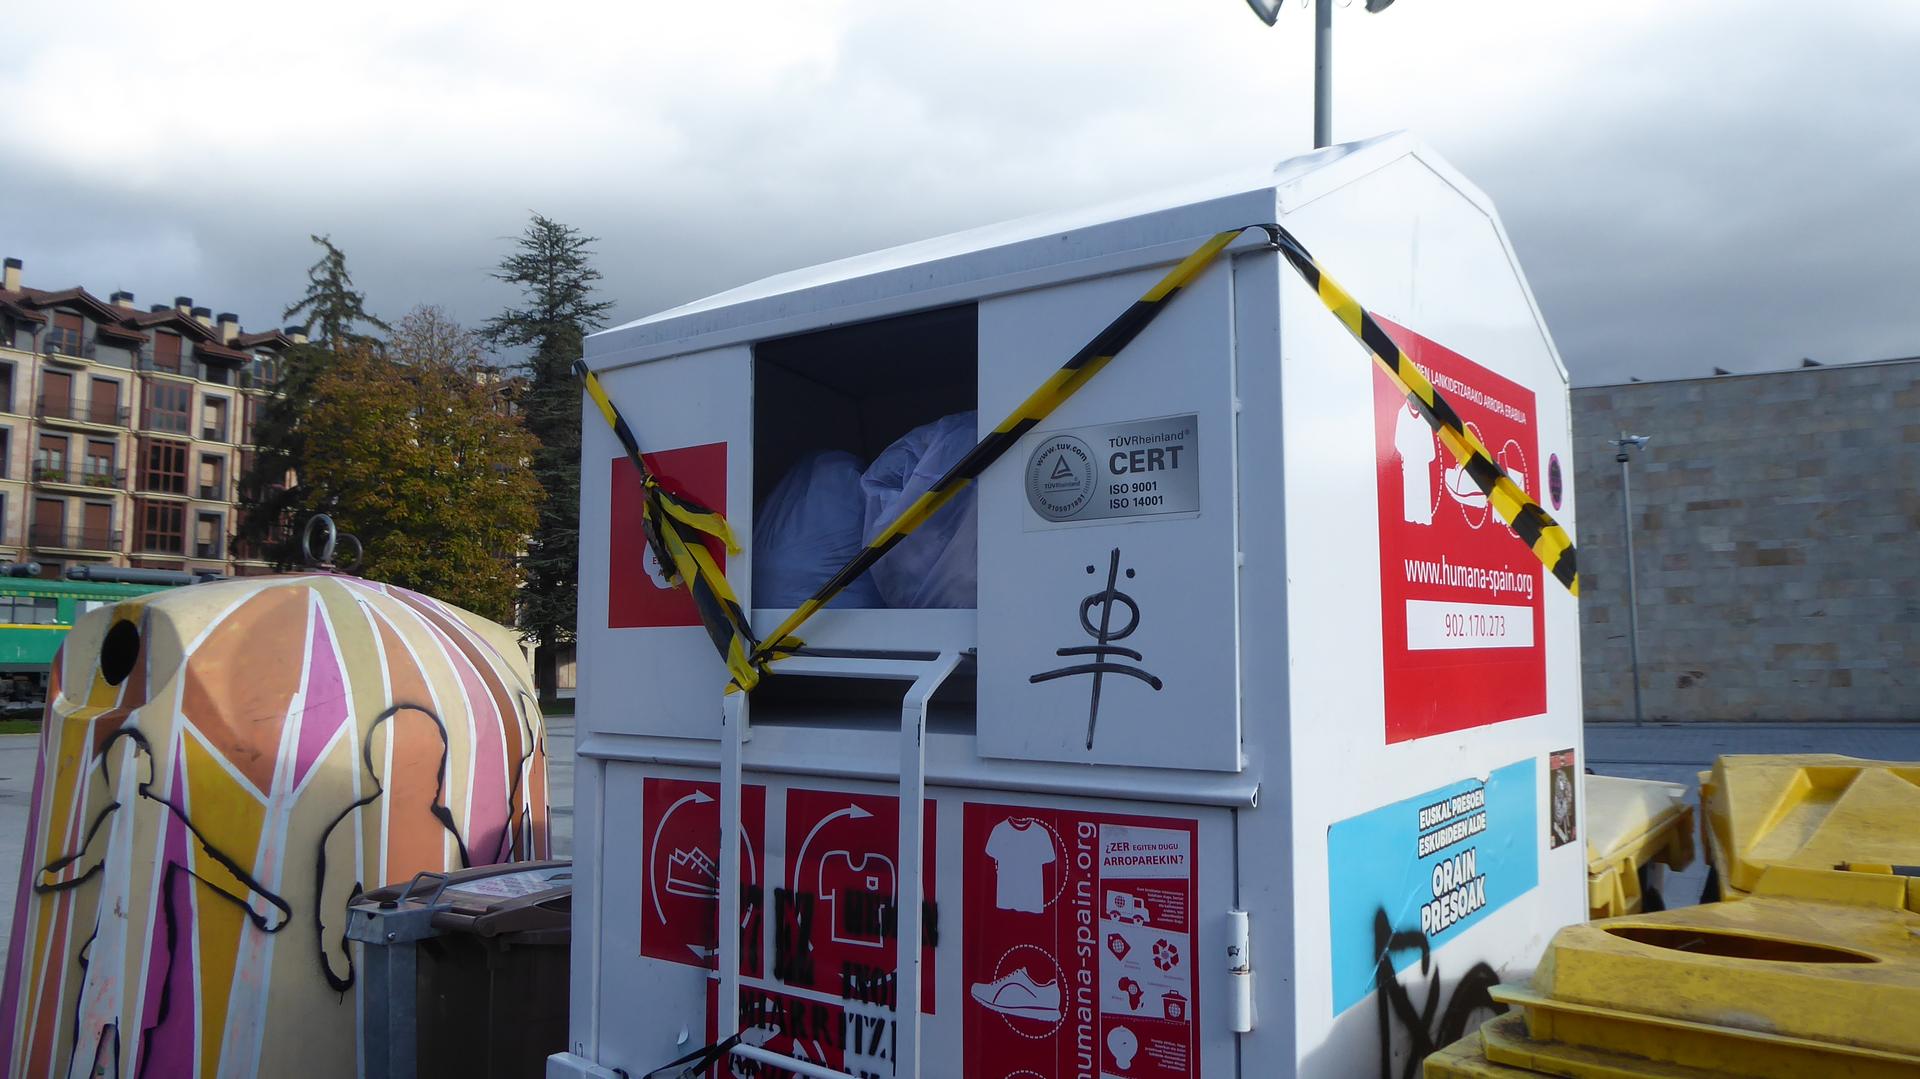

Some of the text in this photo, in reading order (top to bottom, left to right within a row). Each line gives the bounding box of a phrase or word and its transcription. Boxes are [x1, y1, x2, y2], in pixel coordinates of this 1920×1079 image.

[1484, 394, 1505, 415] ARROPA
[1036, 443, 1088, 467] www.tuv.com
[1109, 446, 1183, 475] CERT
[1109, 481, 1157, 495] ISO 9001
[1109, 495, 1164, 509] ISO 14001
[1404, 555, 1533, 600] www.humana-spain.org
[1445, 613, 1506, 637] 902.170.273
[1419, 787, 1485, 831] EUSKAL PRESOEN
[1418, 811, 1486, 859] ESKUBIDEEN ALDE
[1105, 842, 1130, 854] ¿ZER
[1103, 855, 1184, 866] ARROPAREKIN?
[1432, 847, 1475, 897] ORAIN
[1421, 874, 1486, 936] PRESOAK
